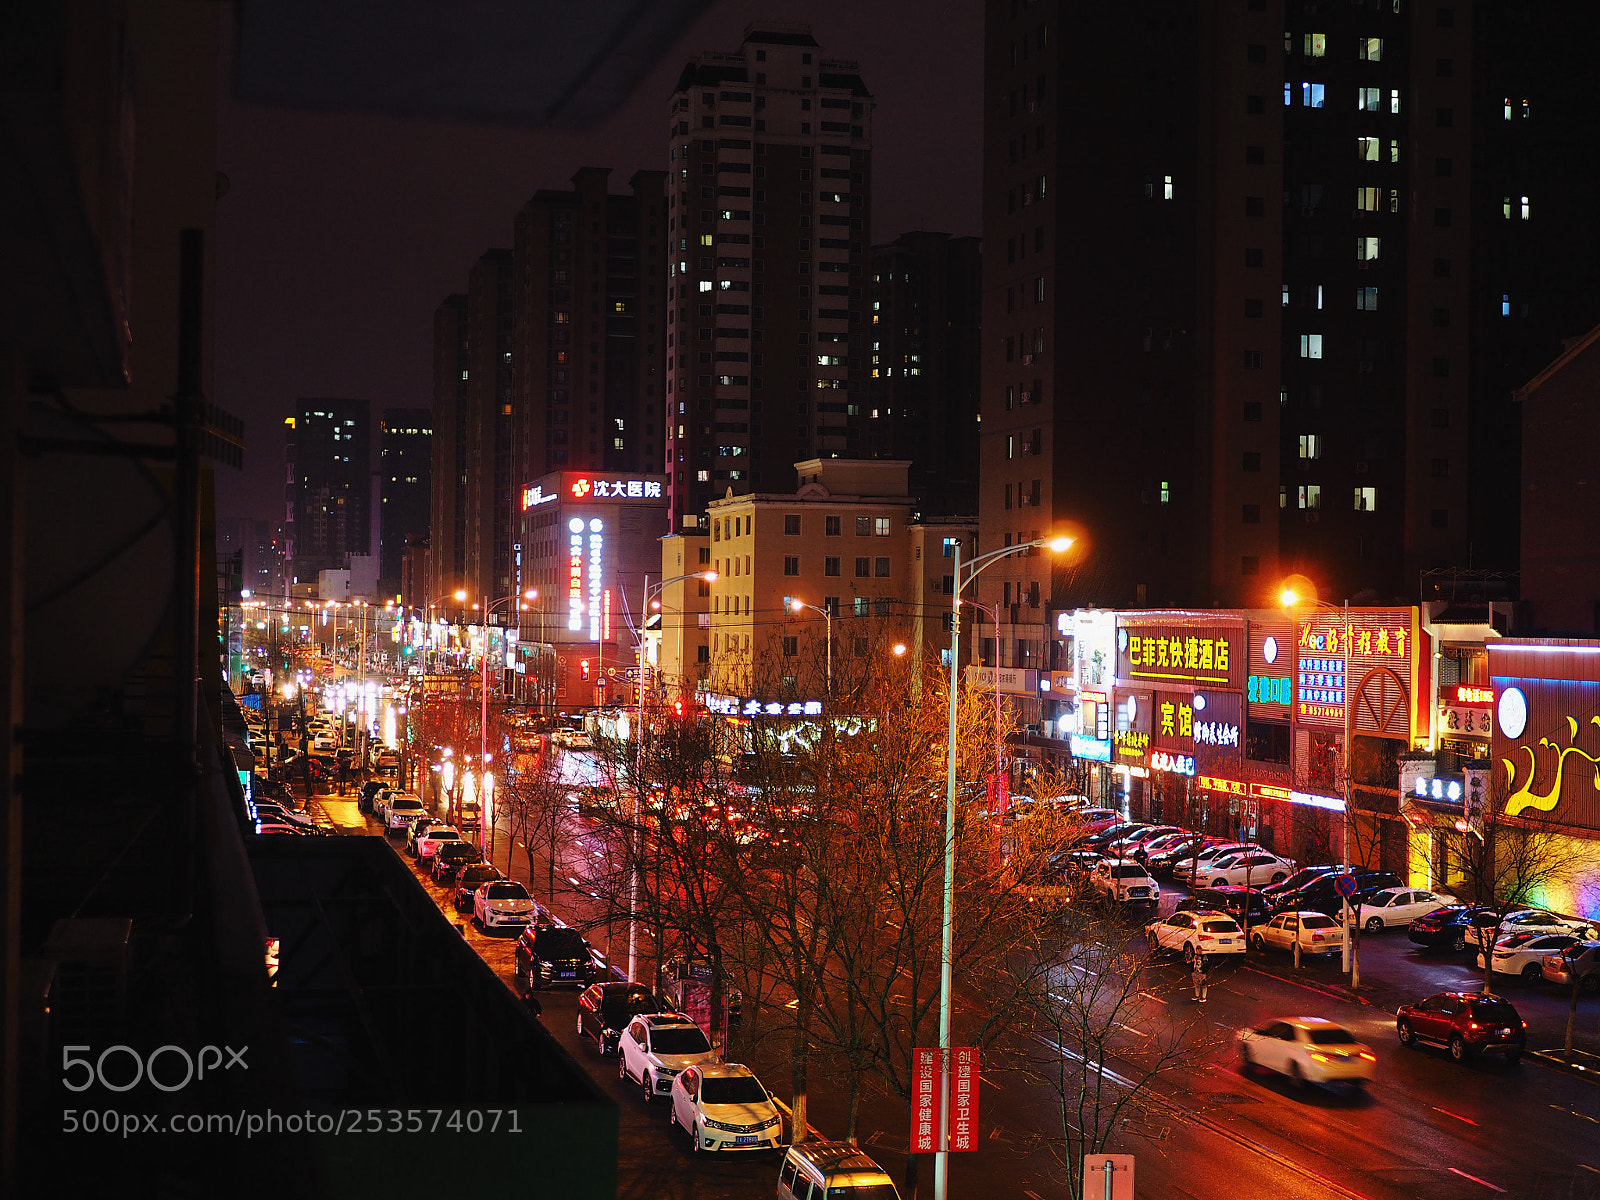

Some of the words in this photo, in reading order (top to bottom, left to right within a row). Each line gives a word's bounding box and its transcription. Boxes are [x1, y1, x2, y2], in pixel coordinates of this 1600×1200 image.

[593, 480, 661, 498] 沈大医院
[1129, 635, 1229, 671] 巴菲克快捷酒店
[1160, 700, 1193, 737] 宾馆
[918, 1051, 933, 1149] 建设国家健康城
[956, 1050, 971, 1149] 创建国家卫生城
